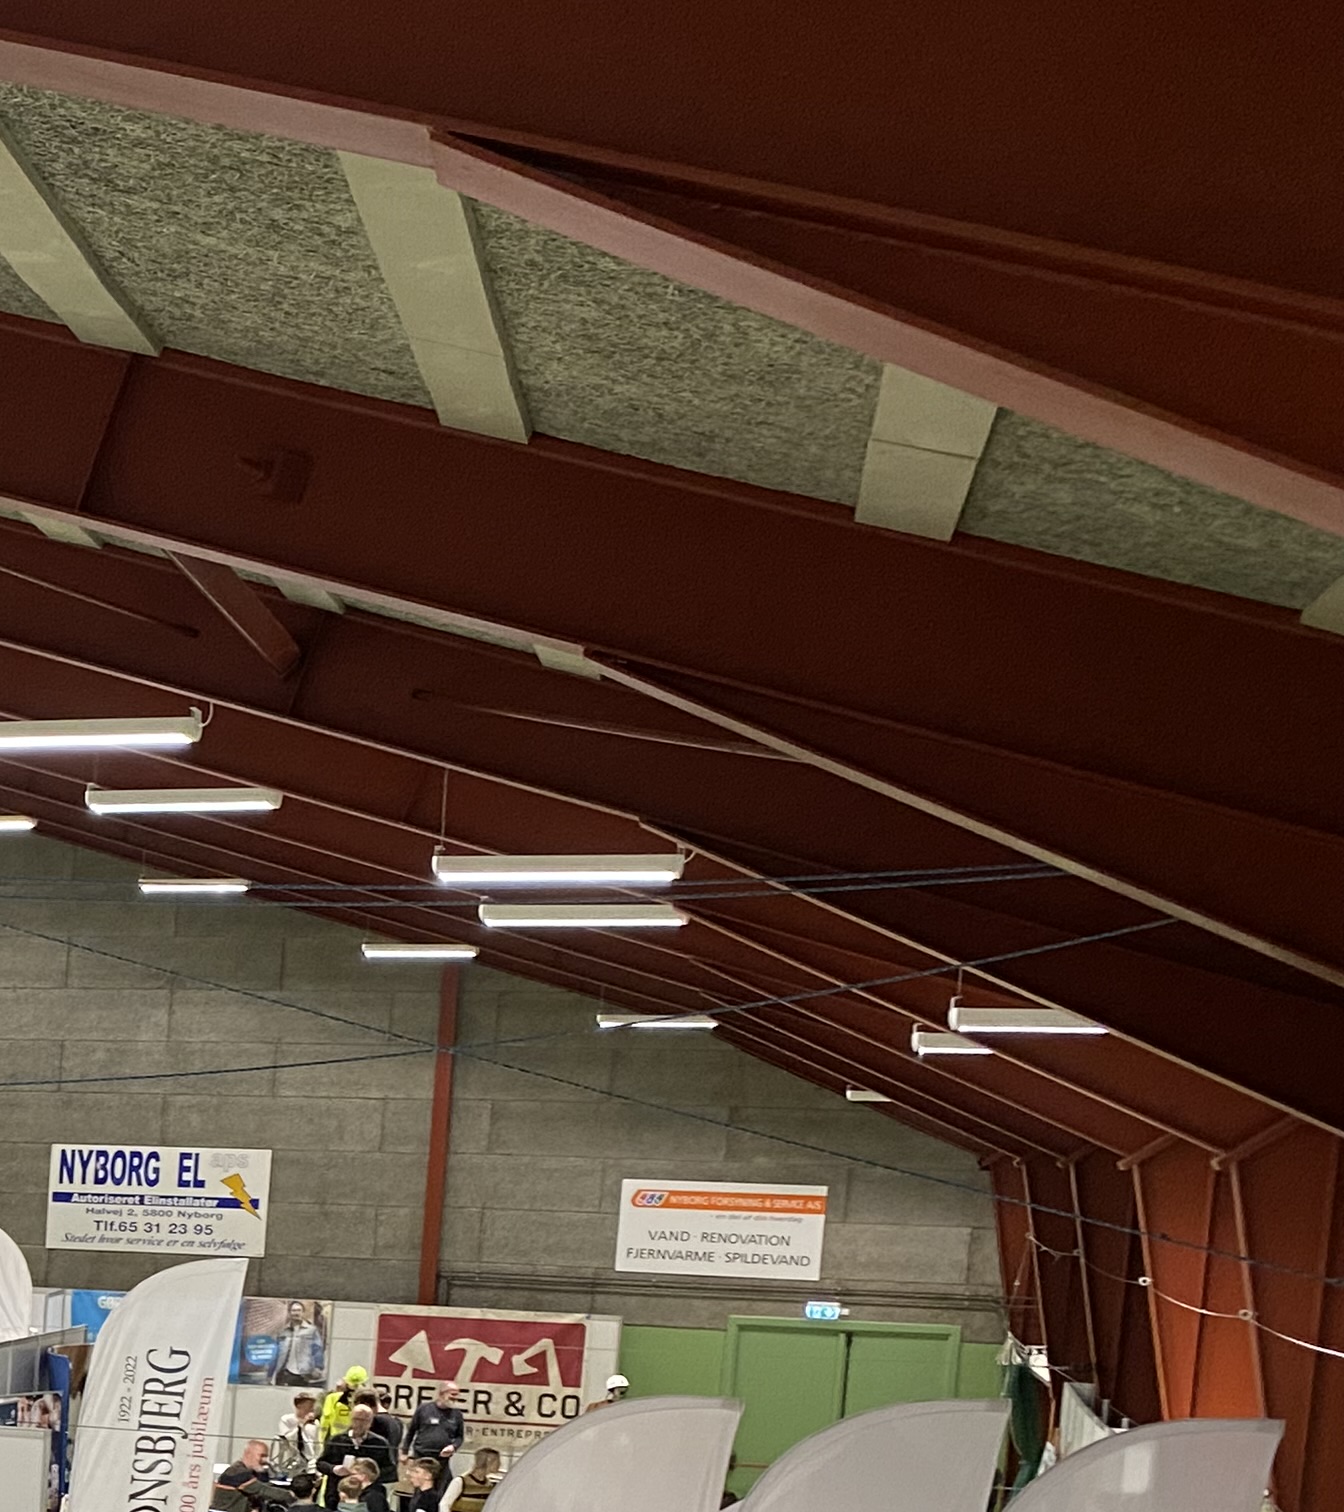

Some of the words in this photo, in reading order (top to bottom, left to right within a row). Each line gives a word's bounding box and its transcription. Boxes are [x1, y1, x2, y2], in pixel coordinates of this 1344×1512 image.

[58, 1149, 160, 1188] NYBORG
[177, 1152, 206, 1189] EL
[209, 1152, 250, 1172] aps
[71, 1193, 140, 1206] Autoriseret
[142, 1210, 173, 1218] 5800
[178, 1211, 224, 1220] Nyborg
[144, 1222, 160, 1234] 31
[168, 1223, 188, 1234] 23
[194, 1224, 214, 1236] 95
[648, 1230, 690, 1242] VAND
[700, 1232, 791, 1246] RENOVATION
[126, 1236, 164, 1247] service
[626, 1248, 715, 1262] FJERNVARME
[724, 1252, 811, 1267] SPILDEVAND
[124, 1355, 138, 1385] 2022
[118, 1396, 134, 1423] 1922
[372, 1382, 492, 1415] BREER
[504, 1391, 526, 1417] &
[537, 1393, 580, 1419] CO
[189, 1376, 214, 1460] jubilæum
[466, 1426, 550, 1440] R-ENTREPR
[186, 1463, 201, 1489] års
